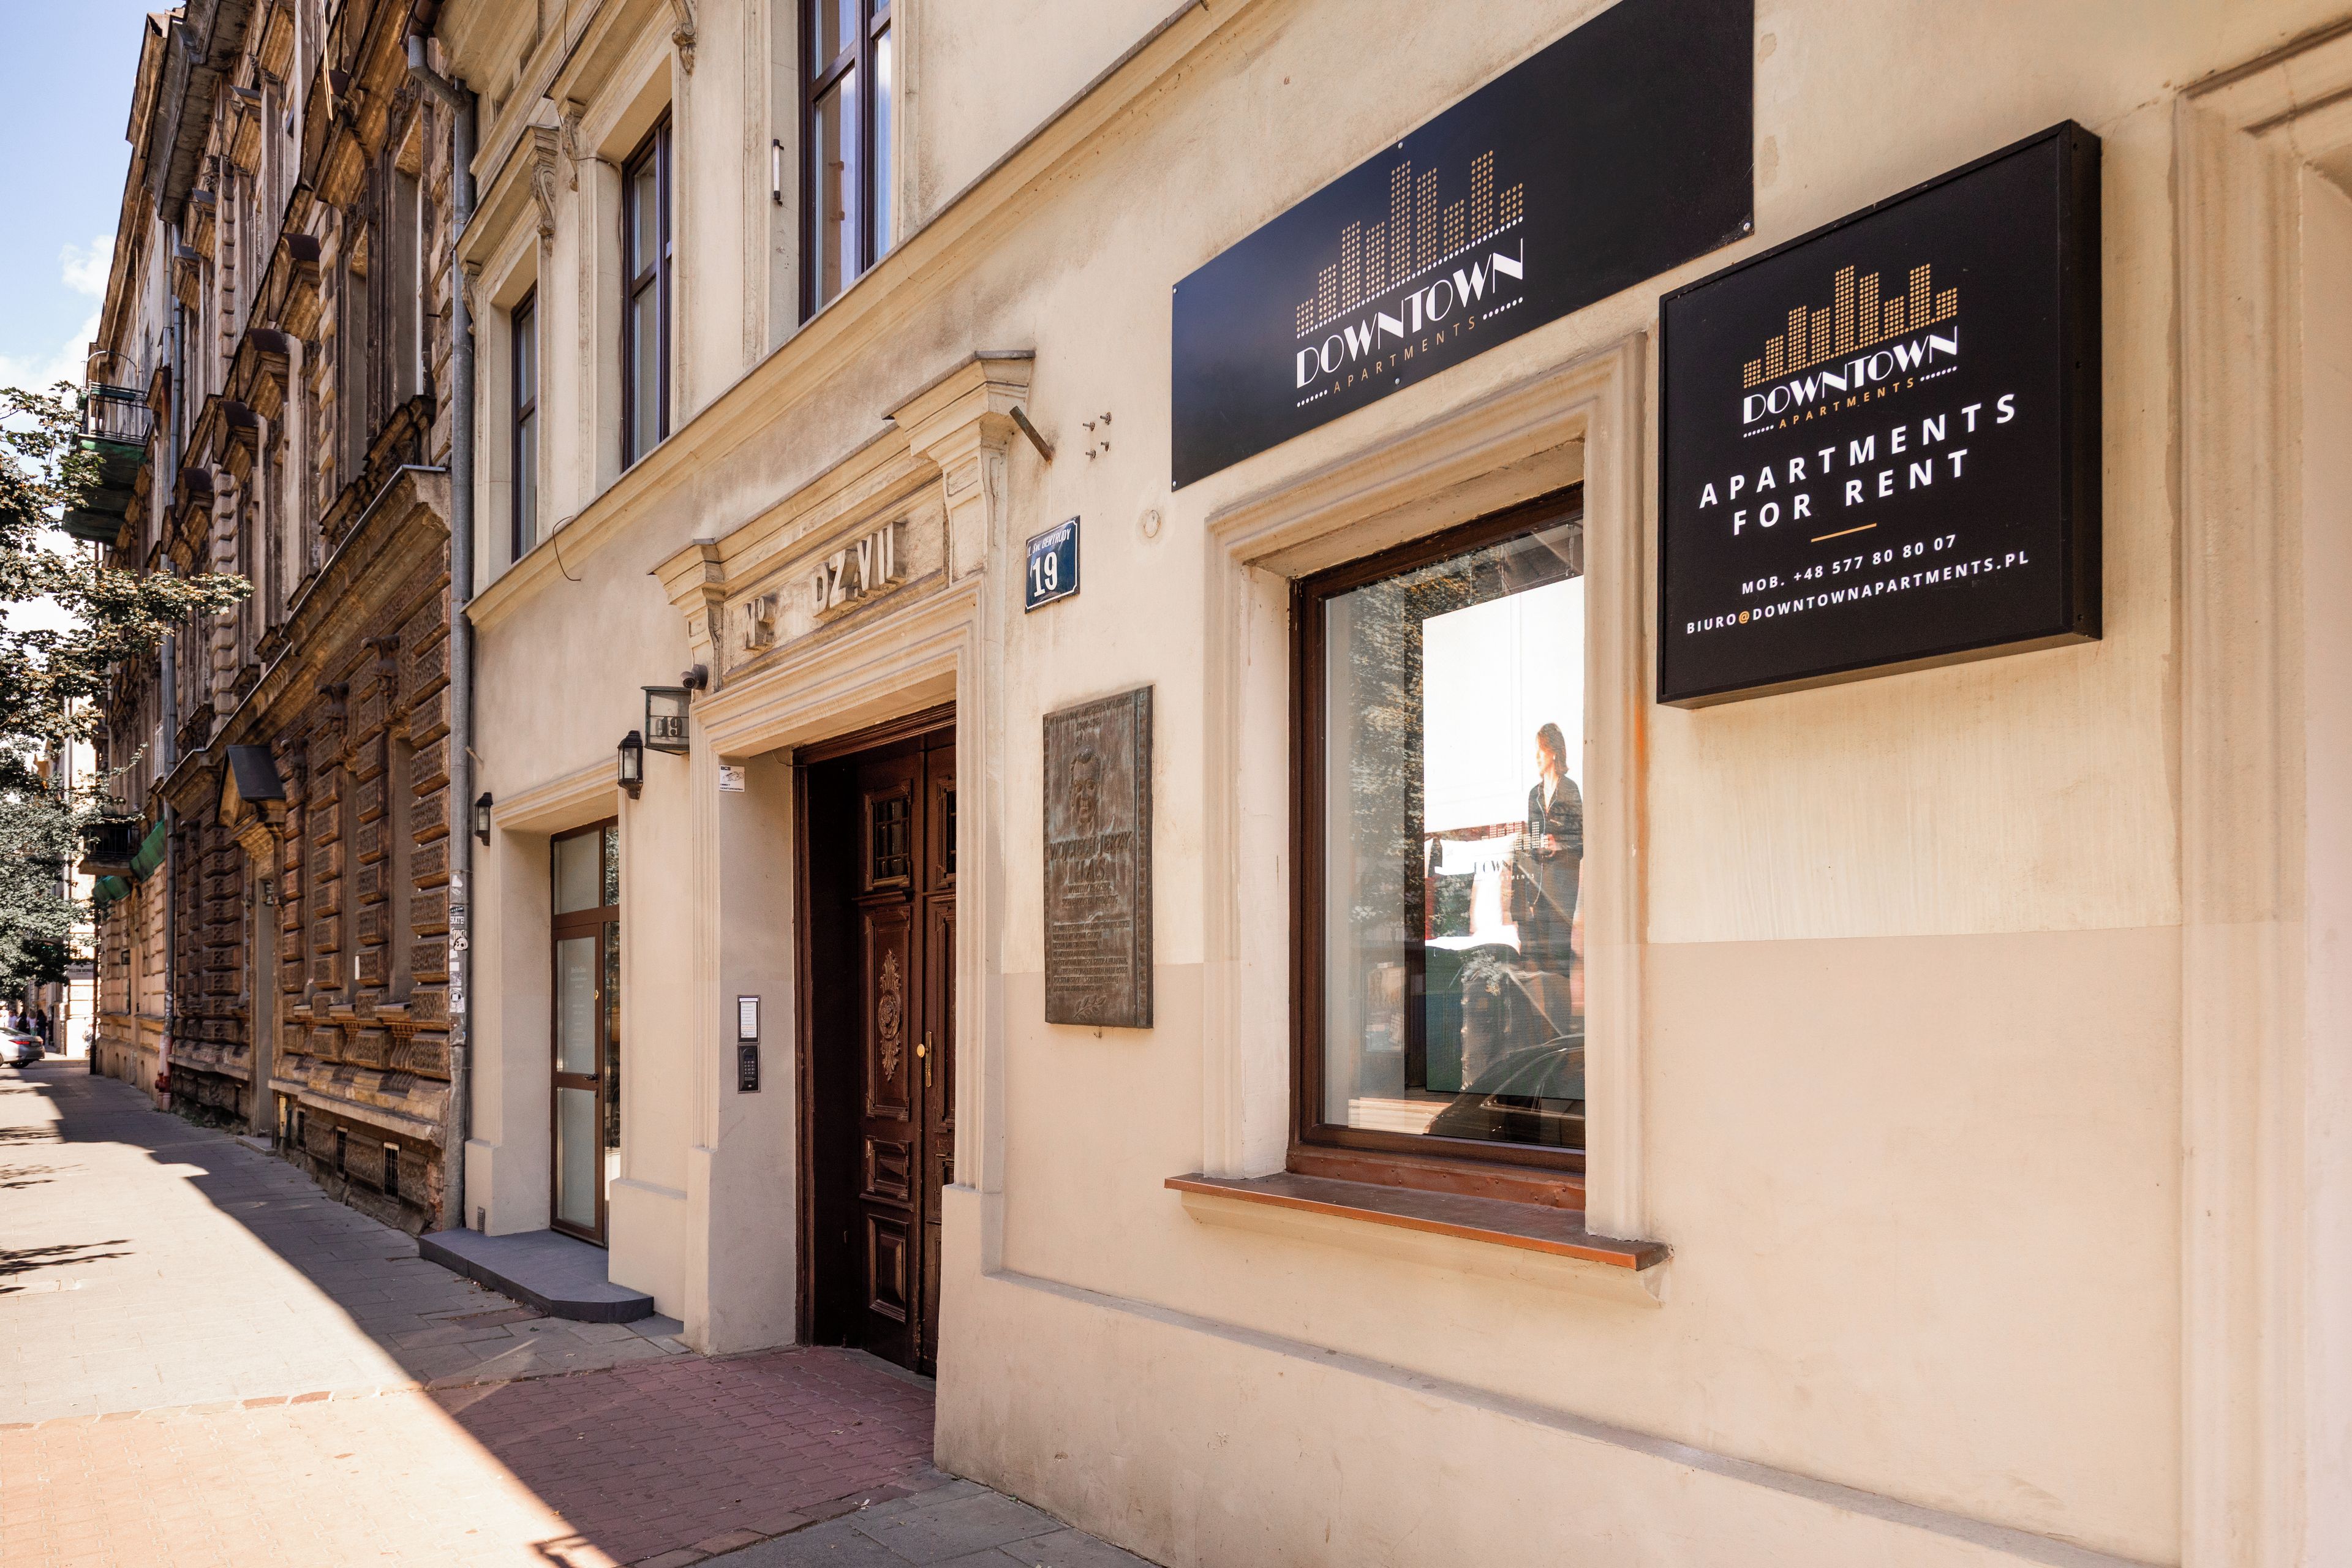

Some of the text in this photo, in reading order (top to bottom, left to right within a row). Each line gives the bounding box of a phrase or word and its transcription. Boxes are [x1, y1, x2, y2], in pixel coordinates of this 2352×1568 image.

[1297, 238, 1523, 389] DOWNTOWN
[1333, 315, 1476, 394] APARTMENTS
[1743, 325, 1958, 424] DOWNTOWN
[1779, 377, 1915, 429] APARTMENTS
[1698, 393, 2016, 509] APARTMENTS
[1733, 449, 1969, 536] FOR RENT
[1033, 551, 1058, 597] 19
[1041, 528, 1071, 549] GERTRUDY
[1742, 534, 1956, 595] MOB. +48 577 80 80 07
[1686, 550, 2029, 635] BIURO@DOWNTOWNAPARTMENTS.PL
[661, 716, 683, 736] 19
